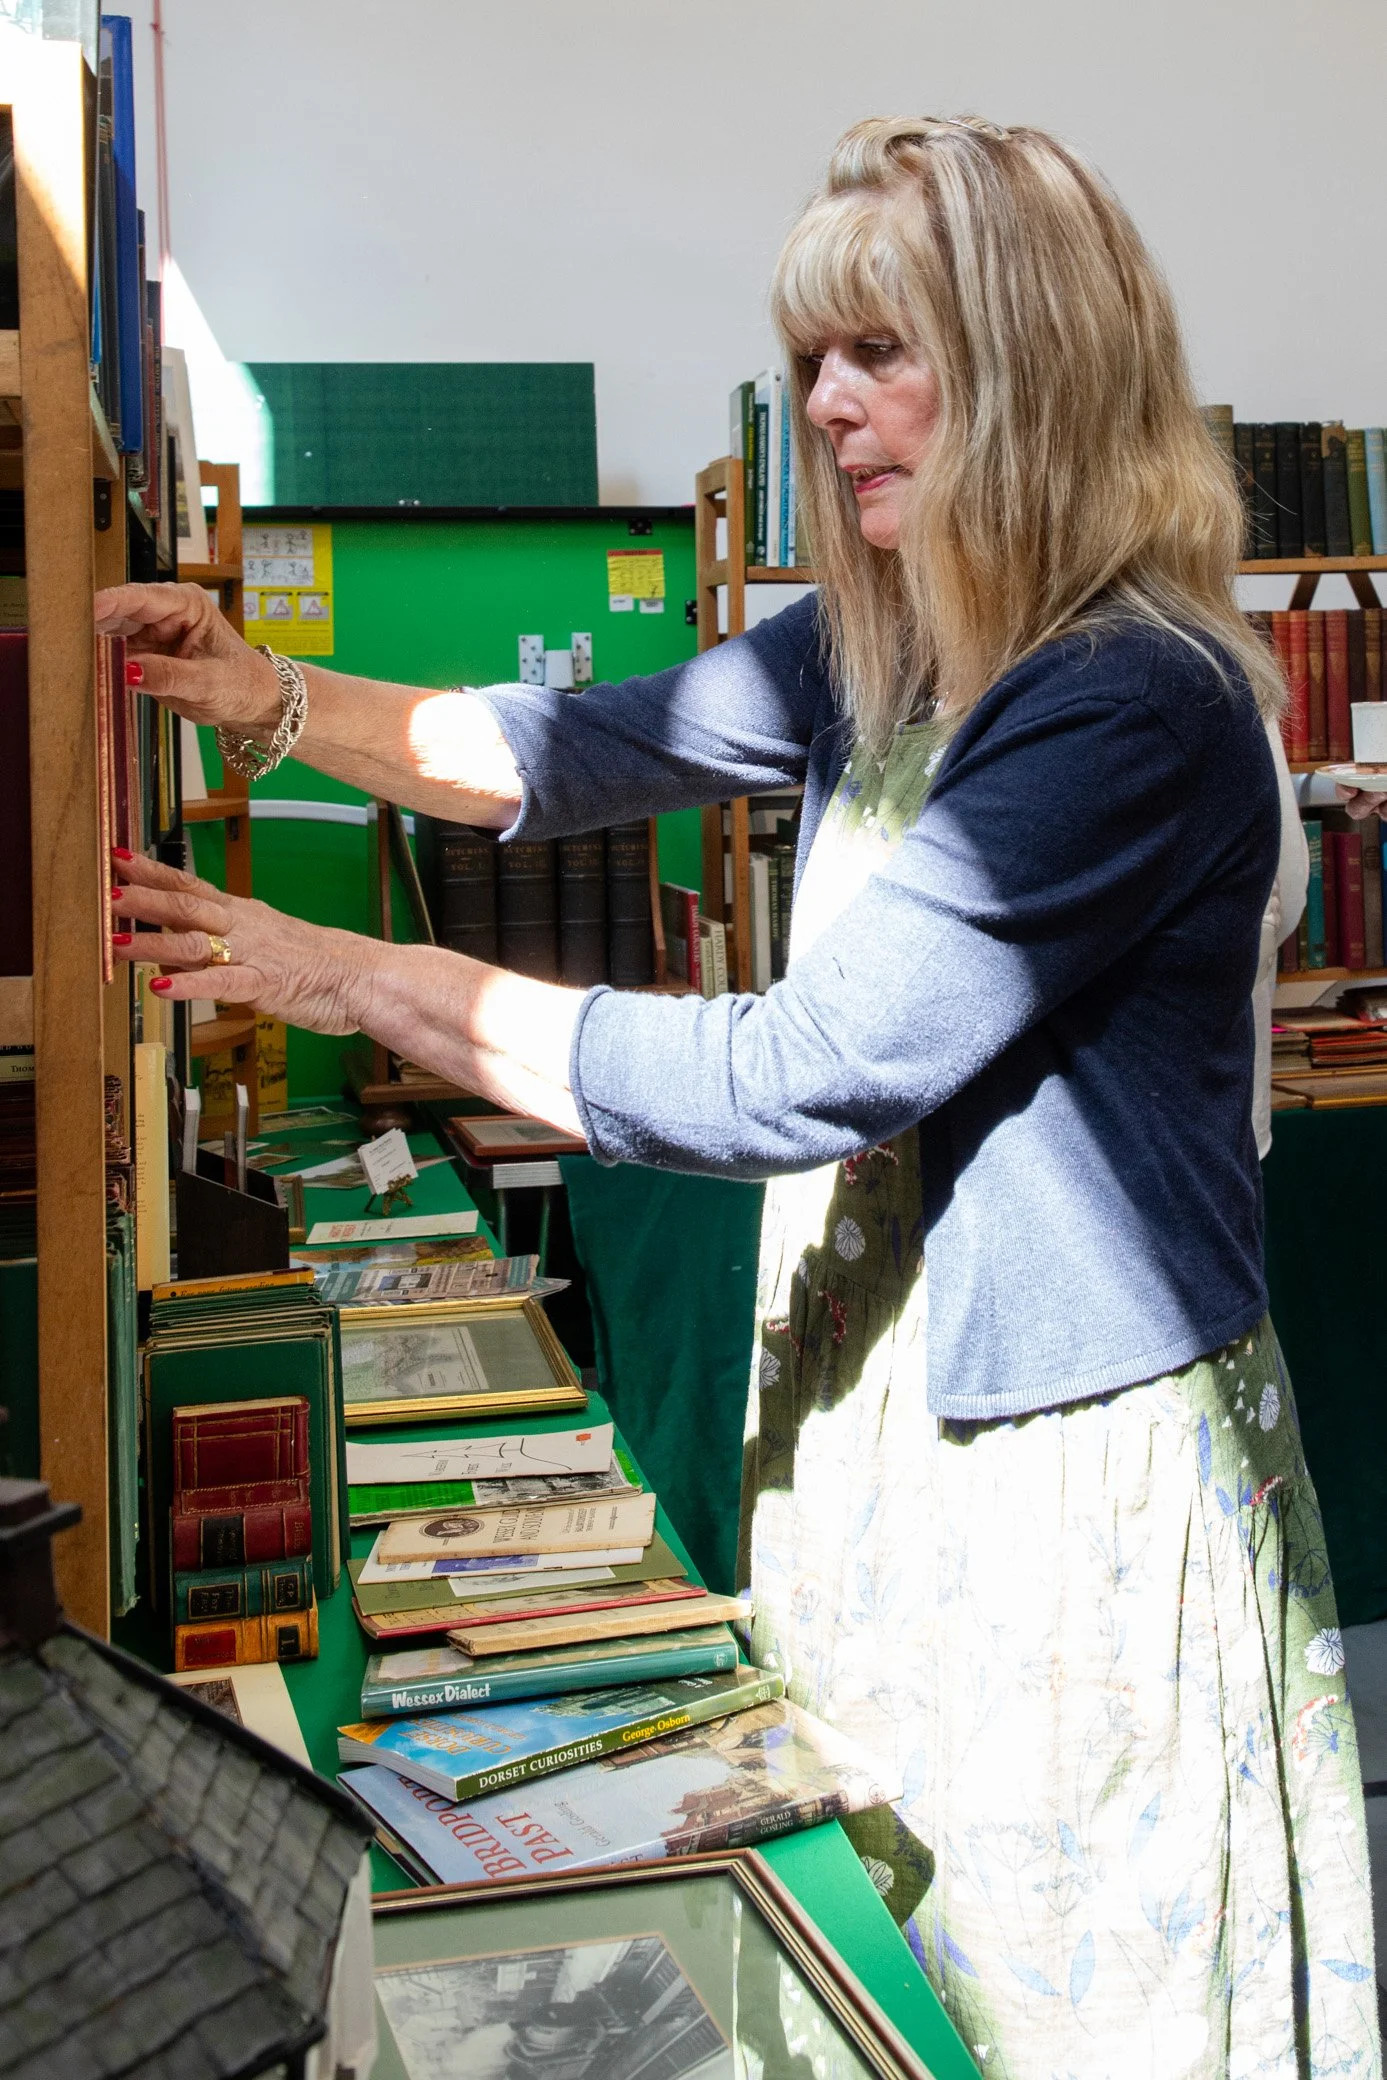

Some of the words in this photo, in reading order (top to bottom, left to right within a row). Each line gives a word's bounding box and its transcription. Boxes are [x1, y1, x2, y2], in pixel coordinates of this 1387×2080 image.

[714, 929, 726, 967] HARDY
[391, 1691, 443, 1709] Wessex
[444, 1682, 491, 1701] Dialect
[621, 1725, 656, 1743] George
[656, 1713, 691, 1733] Osborn
[478, 1764, 527, 1789] DORSET
[528, 1739, 603, 1772] CURIOSITIES
[760, 1810, 792, 1826] GERALD
[760, 1820, 794, 1836] GOSLING
[495, 1811, 575, 1864] PAST
